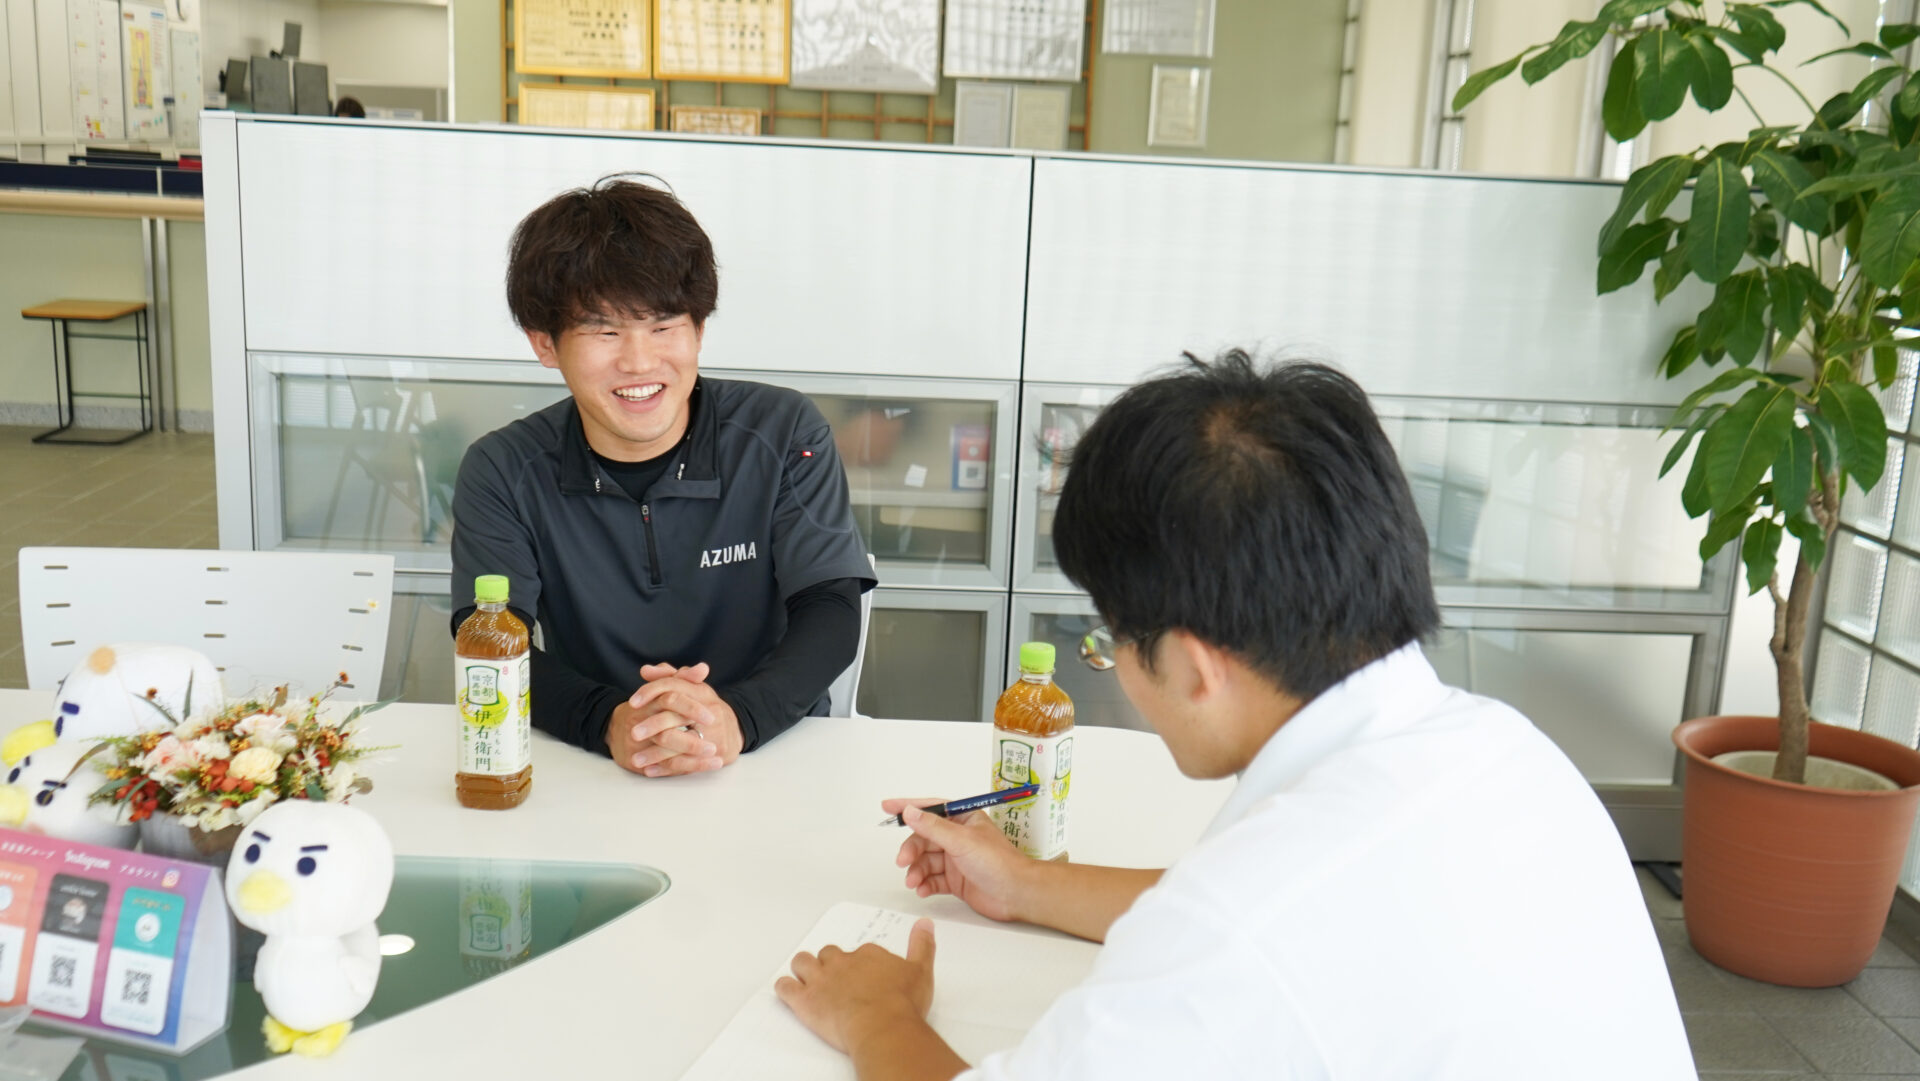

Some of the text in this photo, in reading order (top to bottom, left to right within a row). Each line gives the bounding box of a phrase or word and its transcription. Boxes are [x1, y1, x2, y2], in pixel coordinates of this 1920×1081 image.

[700, 541, 757, 568] AZUMA
[474, 709, 491, 772] 伊右衛門
